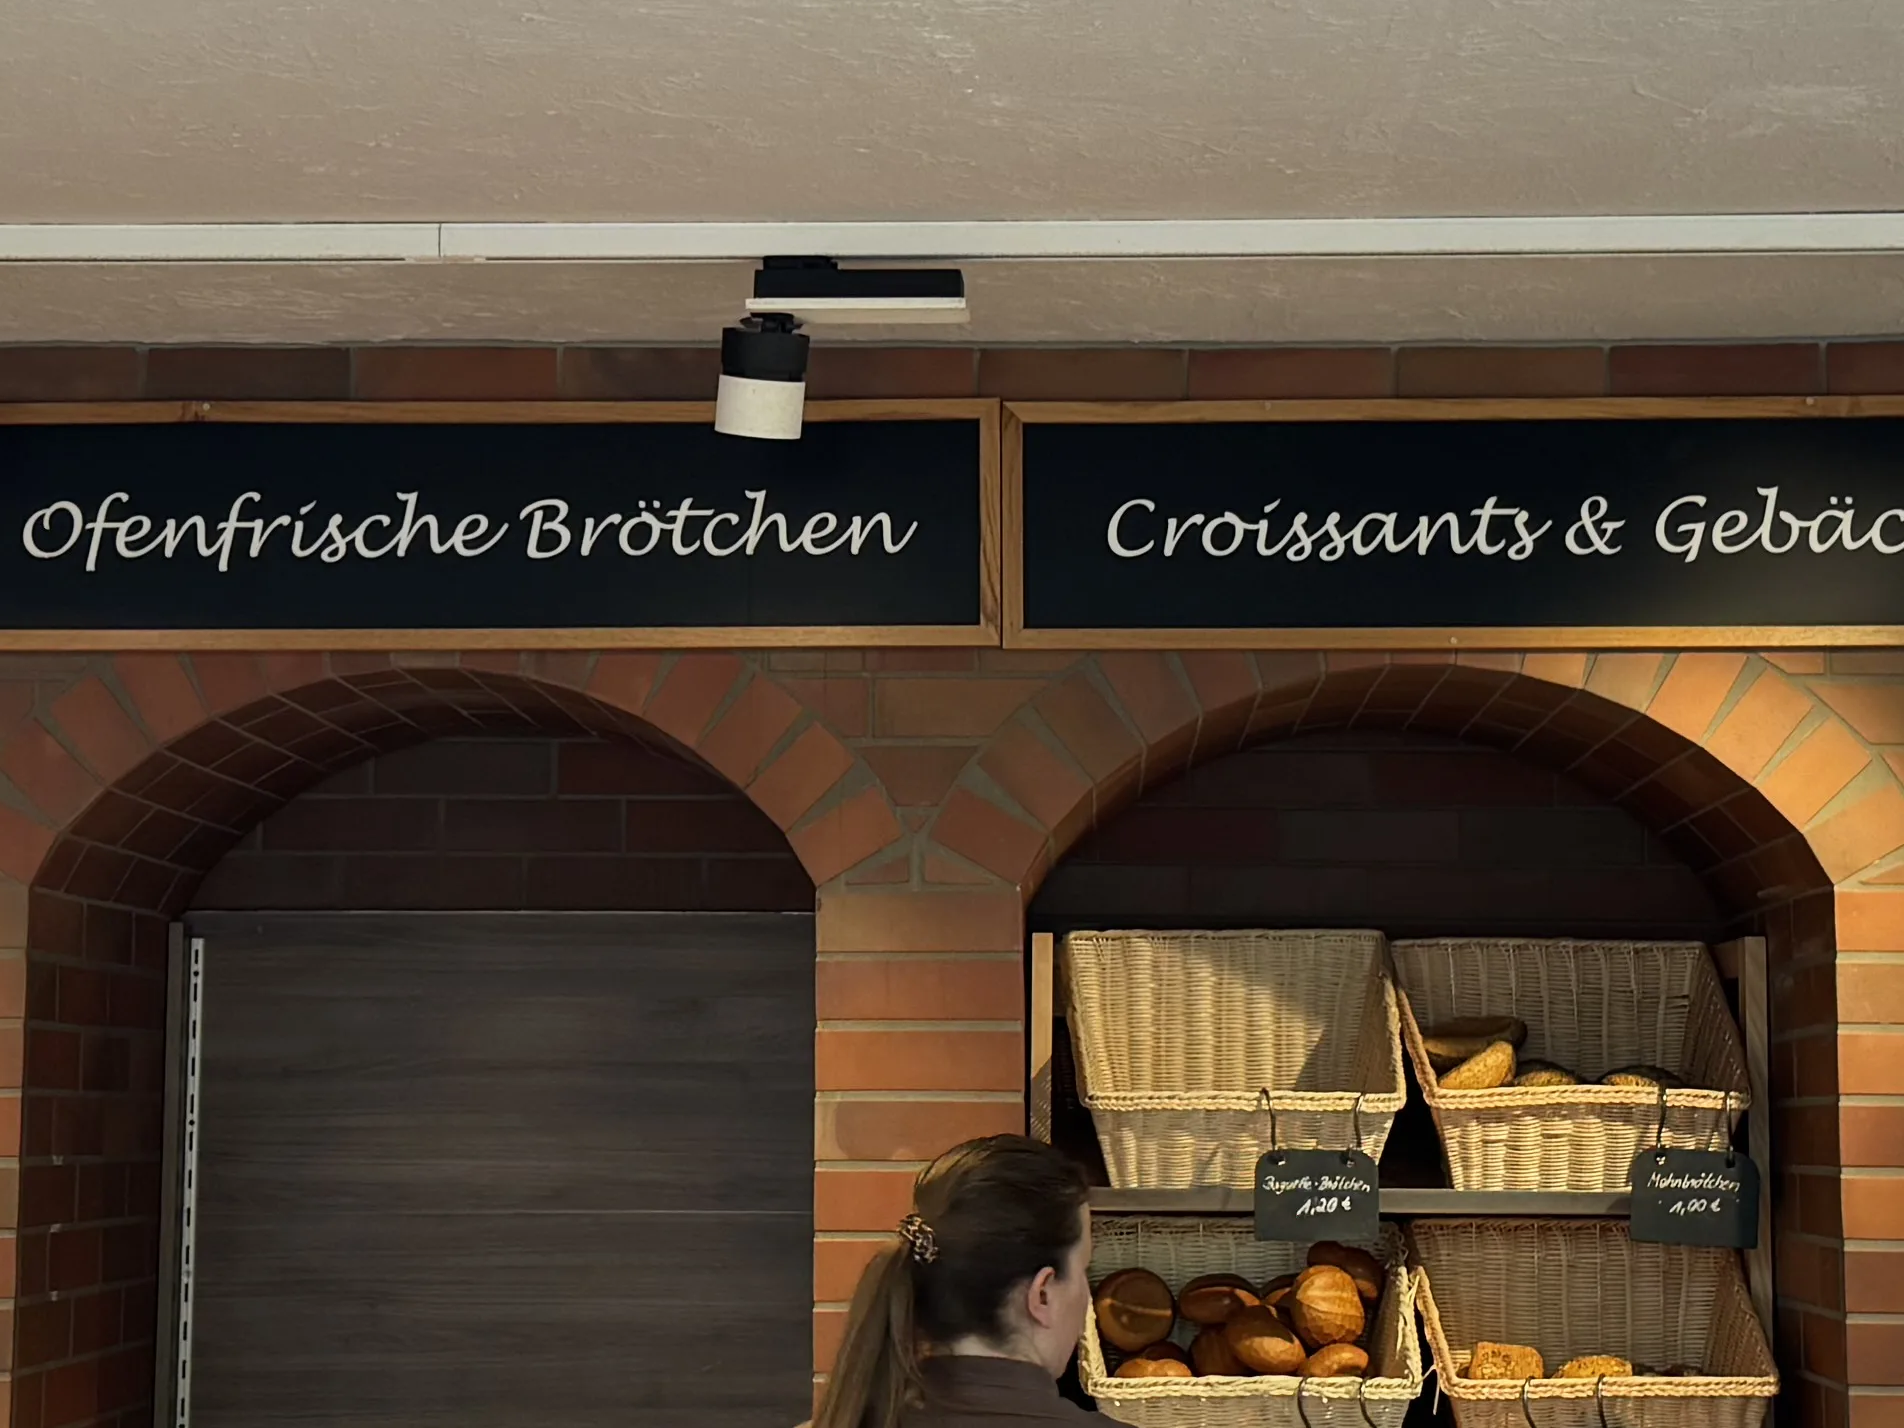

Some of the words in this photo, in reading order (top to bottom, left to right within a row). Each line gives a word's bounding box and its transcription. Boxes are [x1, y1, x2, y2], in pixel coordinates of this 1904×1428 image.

[21, 490, 509, 572] Ofenfrische
[520, 488, 918, 561] Brötchen
[1106, 494, 1553, 561] Croissants
[1564, 494, 1626, 556] &
[1648, 1172, 1740, 1192] Mohnbrötchen
